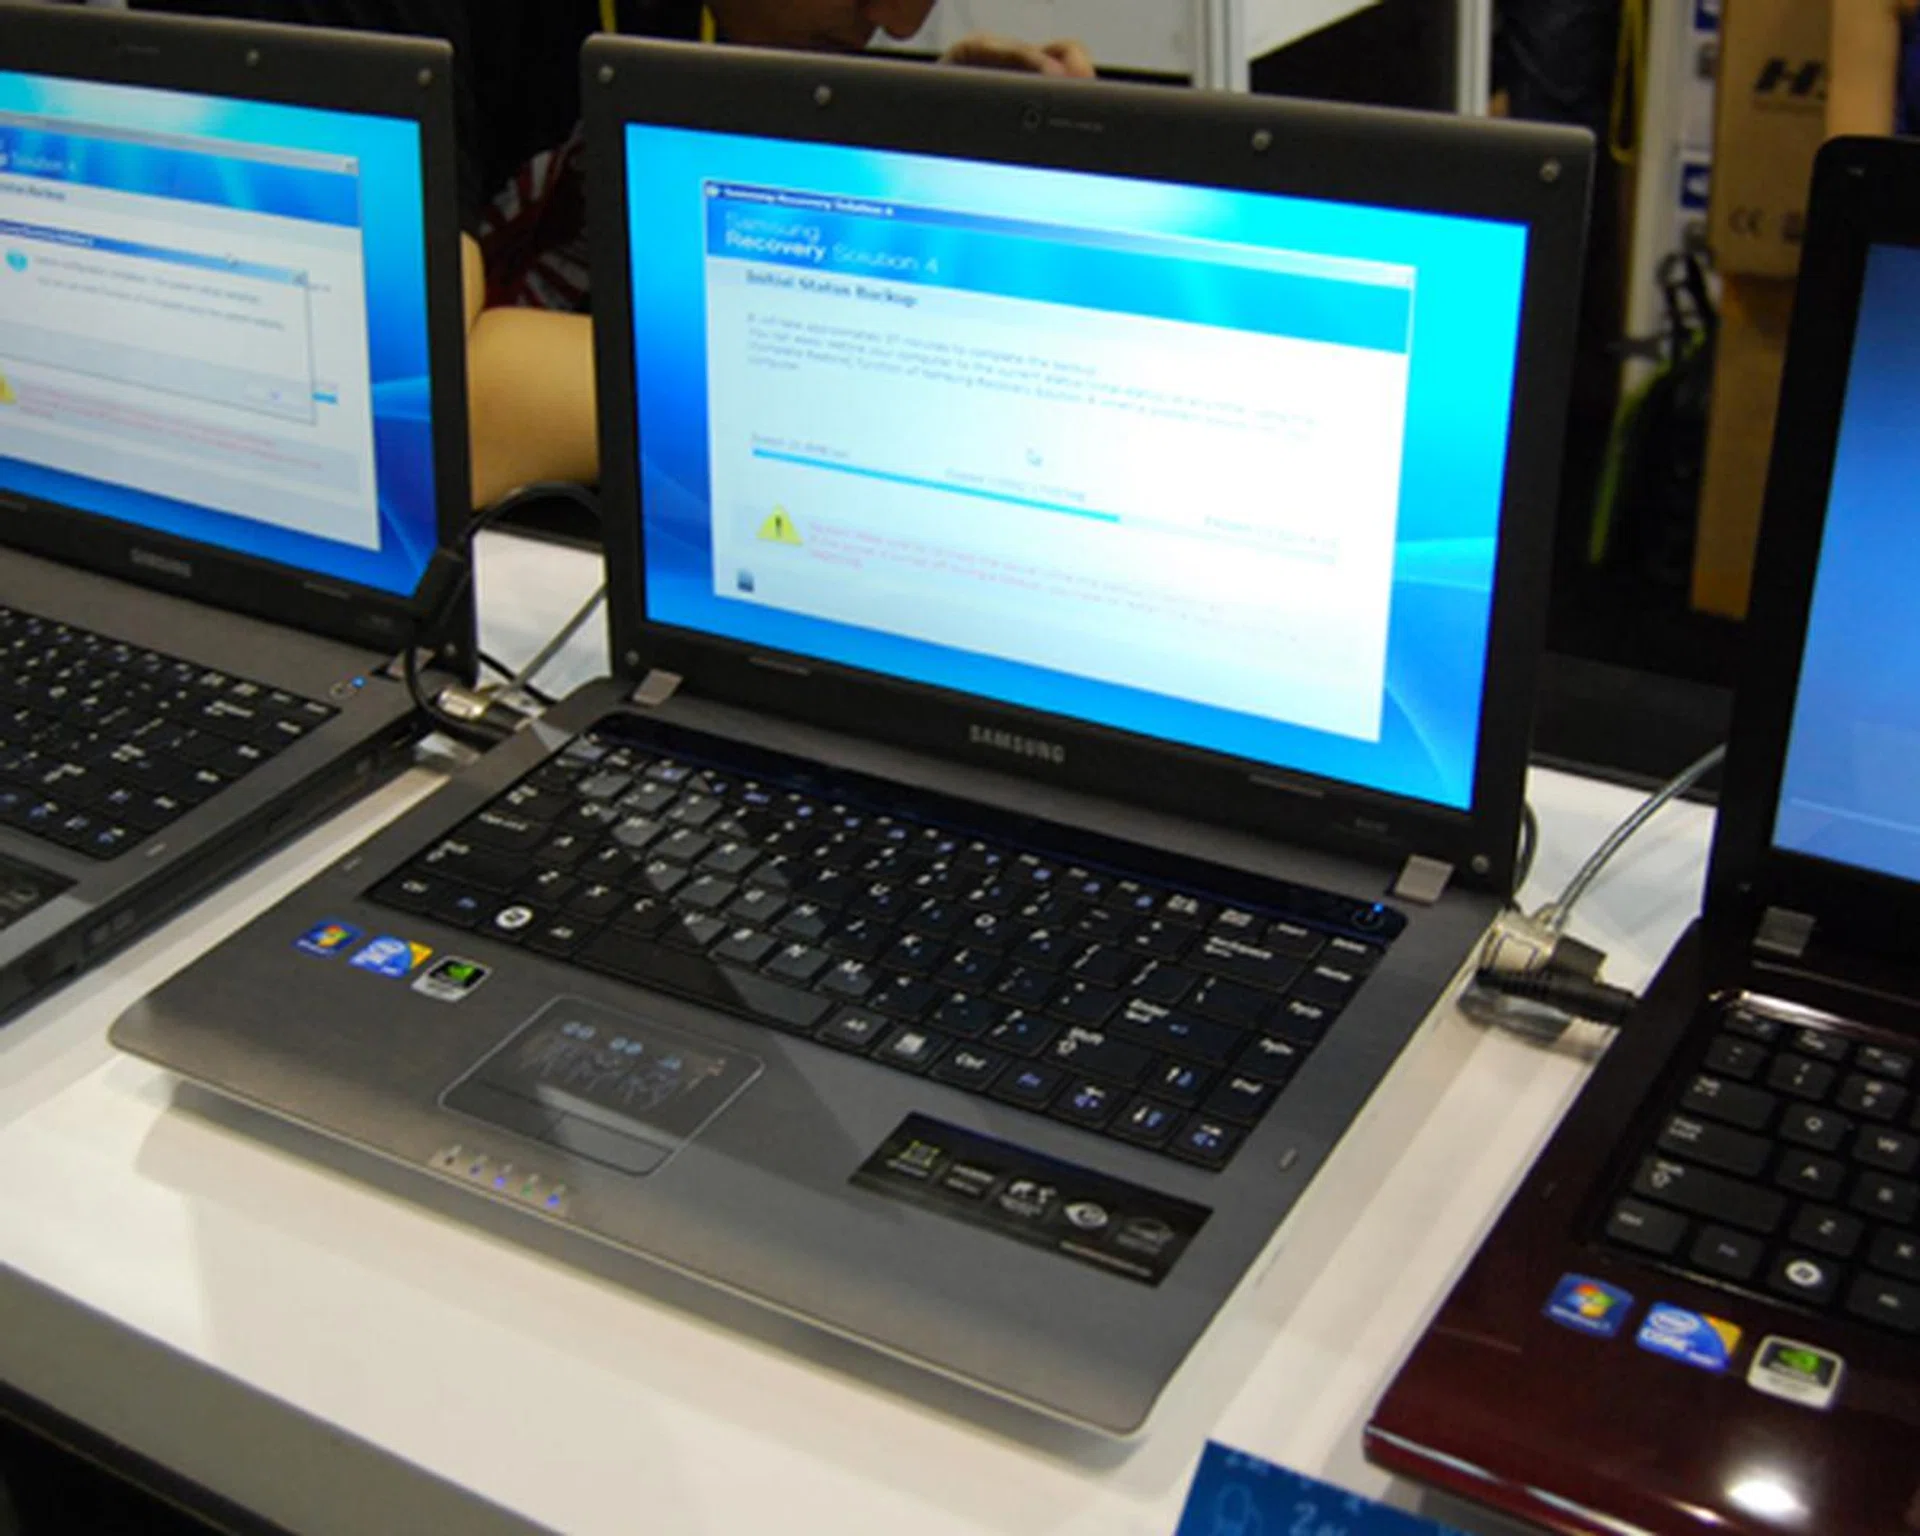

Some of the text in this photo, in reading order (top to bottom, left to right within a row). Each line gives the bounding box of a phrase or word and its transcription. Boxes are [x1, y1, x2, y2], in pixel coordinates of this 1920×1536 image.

[725, 210, 821, 243] Samsung
[725, 229, 826, 262] Recovery
[831, 242, 920, 272] Solution
[745, 269, 918, 308] Initial Status Backup
[968, 723, 1066, 766] SAMSUNG
